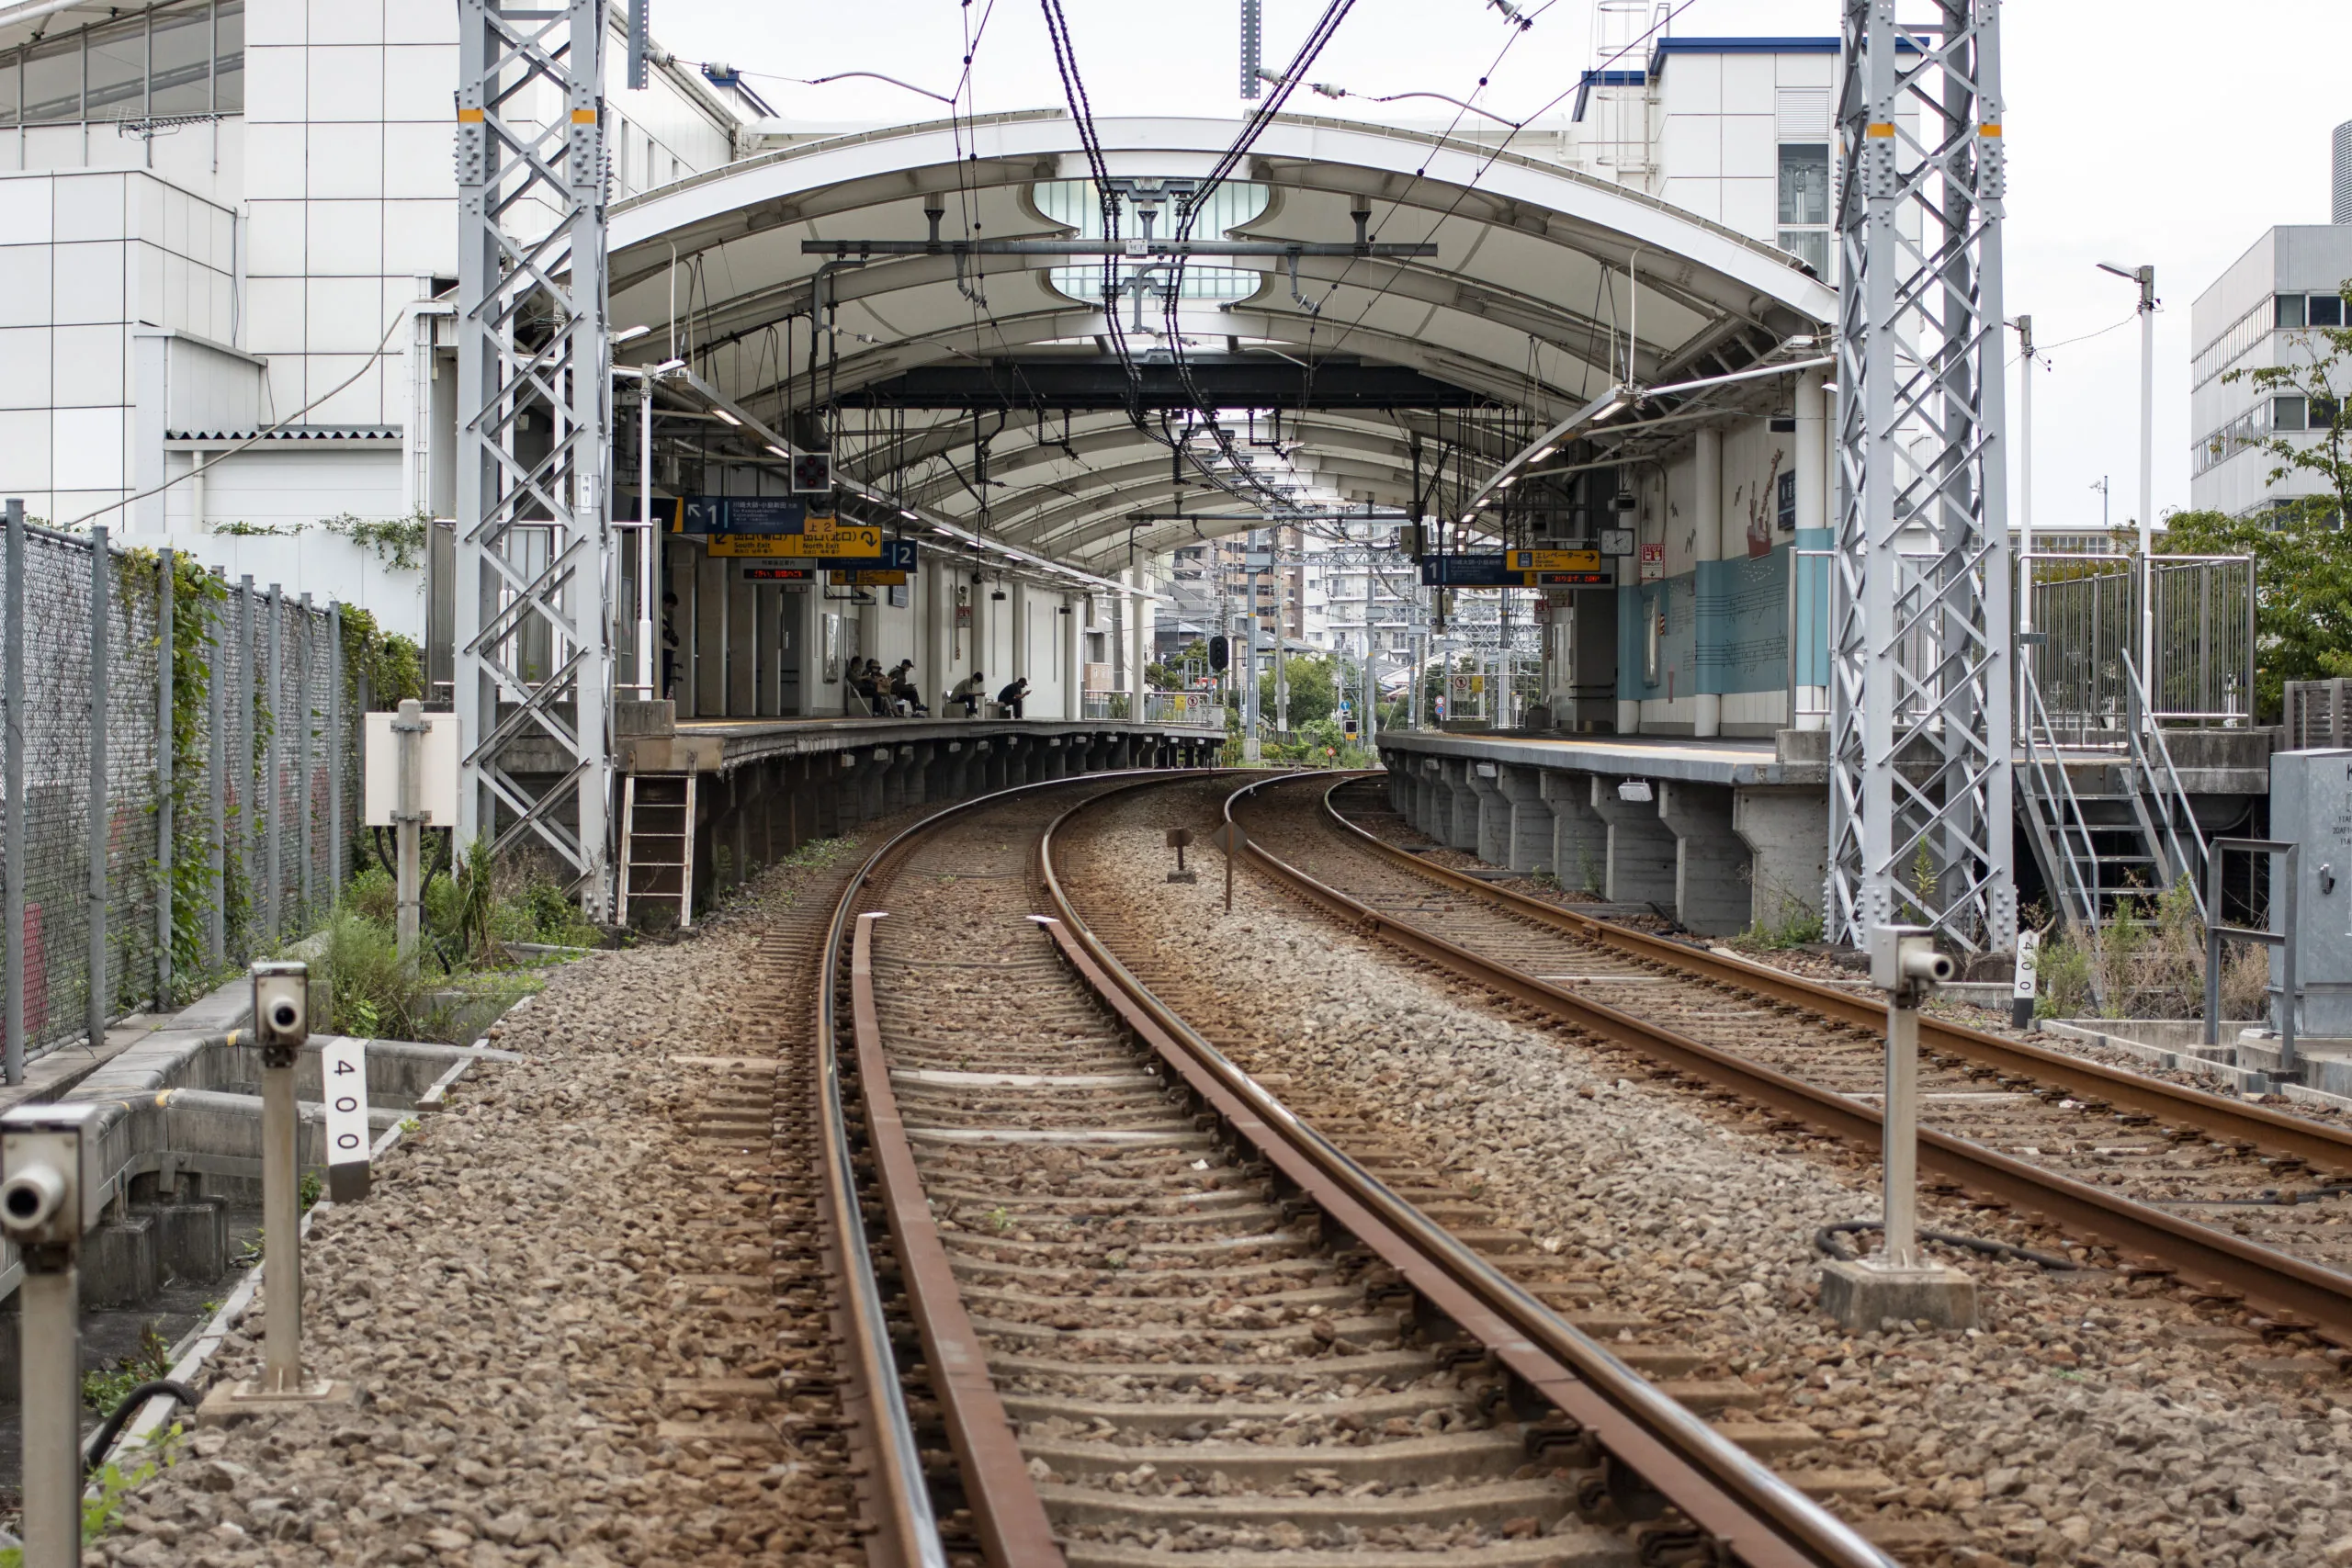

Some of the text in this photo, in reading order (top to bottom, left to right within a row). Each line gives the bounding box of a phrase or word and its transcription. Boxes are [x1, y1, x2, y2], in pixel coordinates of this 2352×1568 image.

[707, 504, 717, 525] 1
[823, 522, 832, 533] 2
[900, 547, 911, 564] 2
[1429, 562, 1438, 579] 1
[2019, 942, 2034, 990] 400
[334, 1059, 359, 1150] 400
